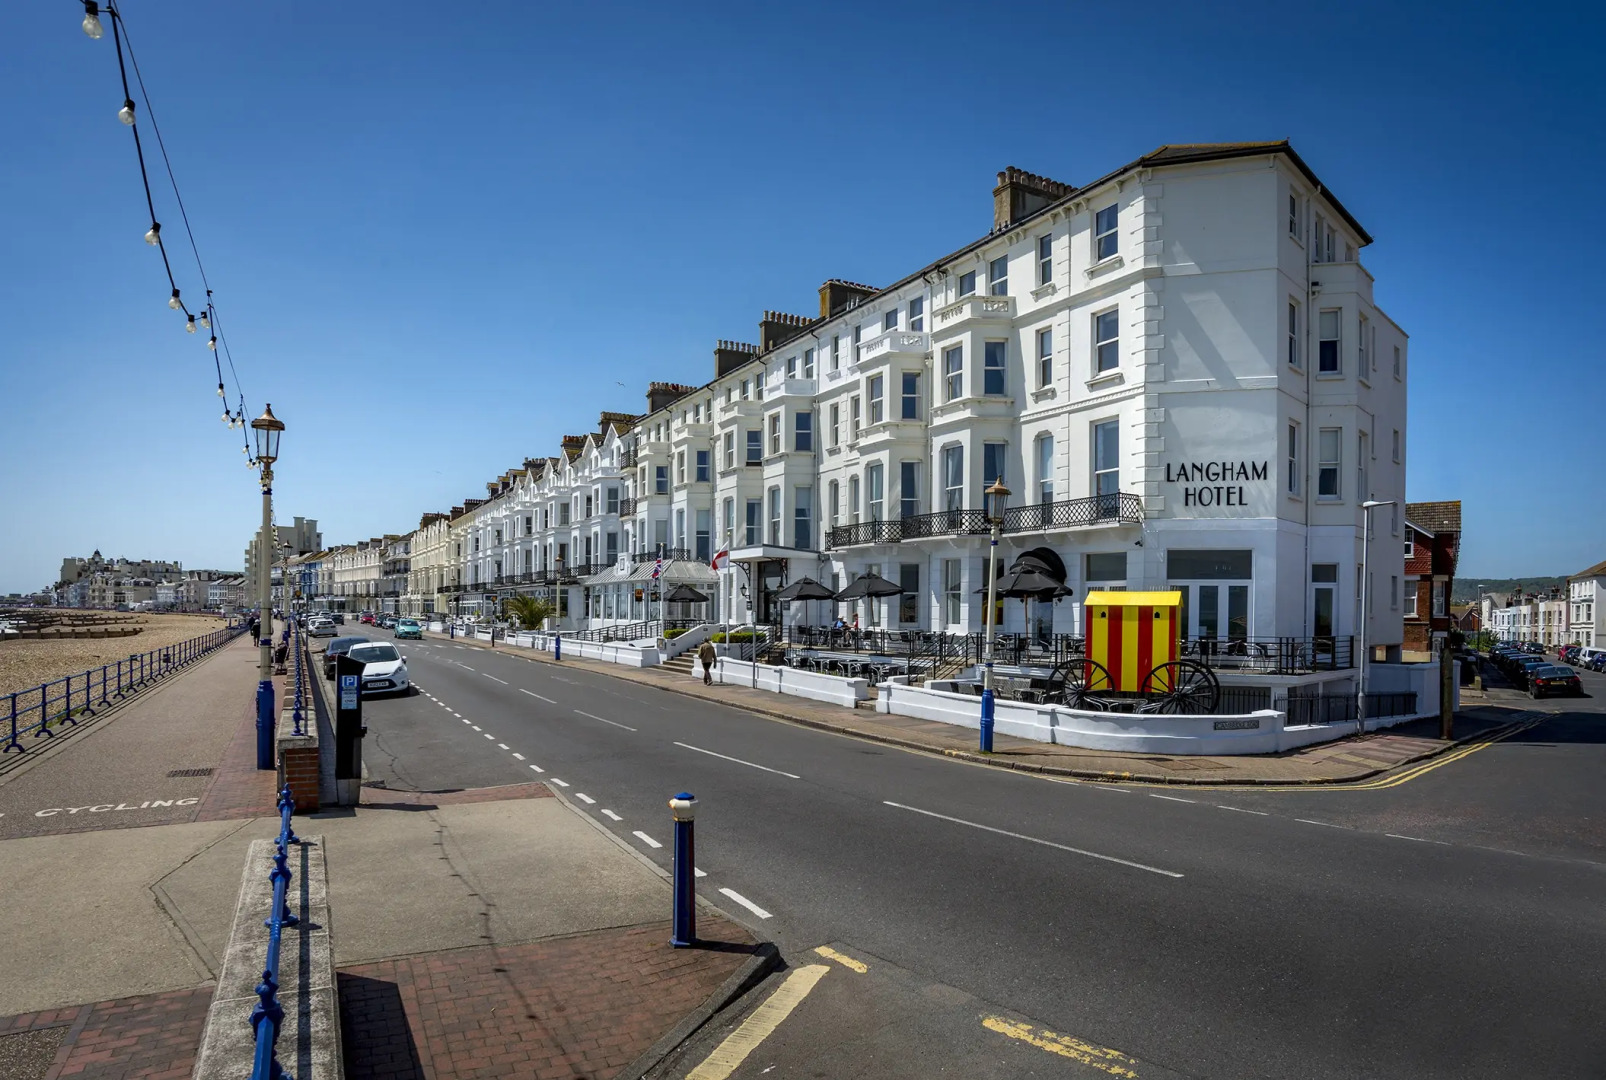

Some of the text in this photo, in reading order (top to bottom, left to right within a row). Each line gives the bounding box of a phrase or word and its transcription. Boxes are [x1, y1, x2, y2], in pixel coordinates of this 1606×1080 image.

[1166, 461, 1268, 482] LANGHAM
[1184, 486, 1248, 507] HOTEL
[346, 677, 354, 686] P
[35, 798, 199, 817] CYCLING
